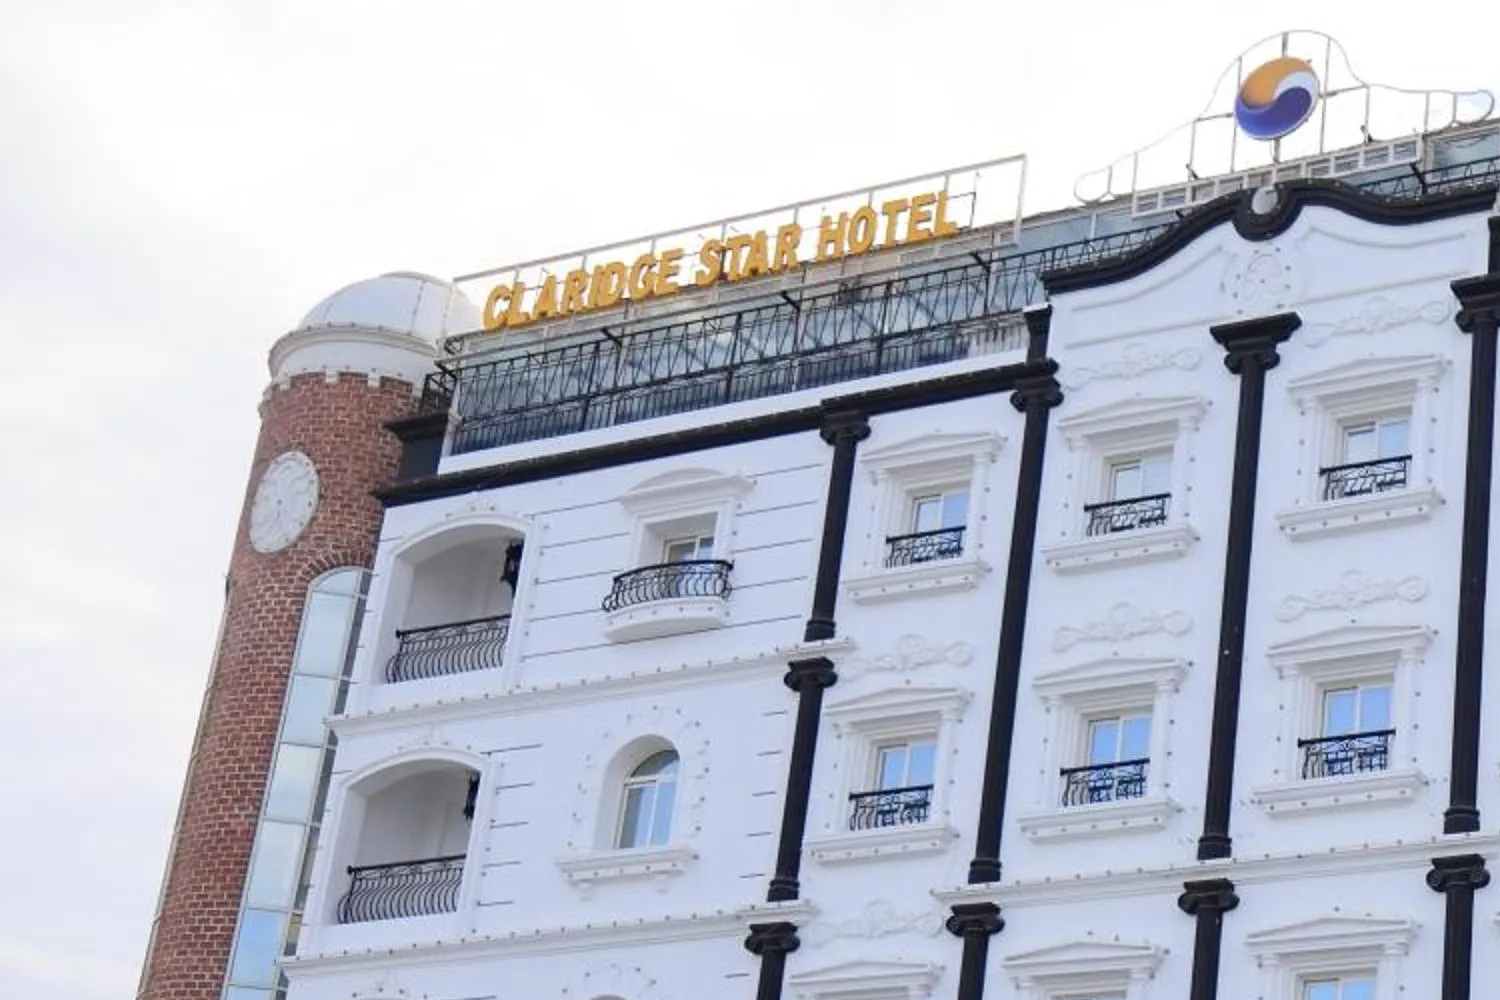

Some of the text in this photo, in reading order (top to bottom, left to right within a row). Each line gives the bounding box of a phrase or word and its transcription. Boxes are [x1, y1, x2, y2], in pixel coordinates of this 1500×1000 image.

[483, 190, 958, 331] CLARIDGE STAR HOTEL
